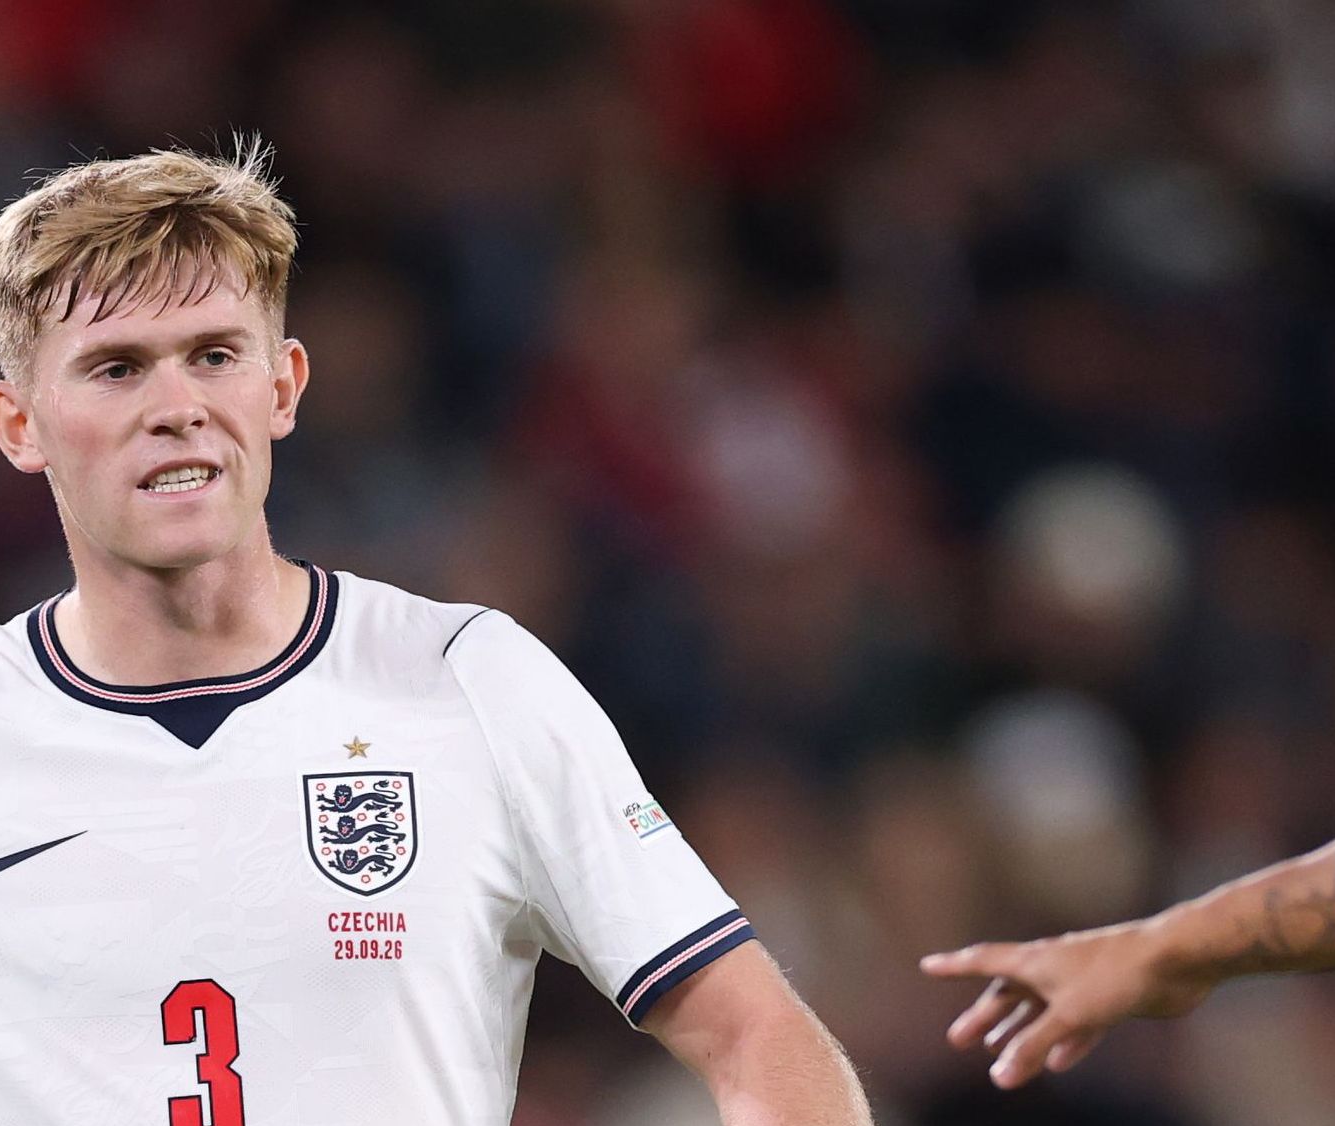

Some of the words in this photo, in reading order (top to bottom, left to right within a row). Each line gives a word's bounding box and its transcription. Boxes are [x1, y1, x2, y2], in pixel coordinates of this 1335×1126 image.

[622, 802, 643, 818] UEFA
[328, 912, 406, 932] CZECHIA
[334, 940, 402, 959] 29.09.26
